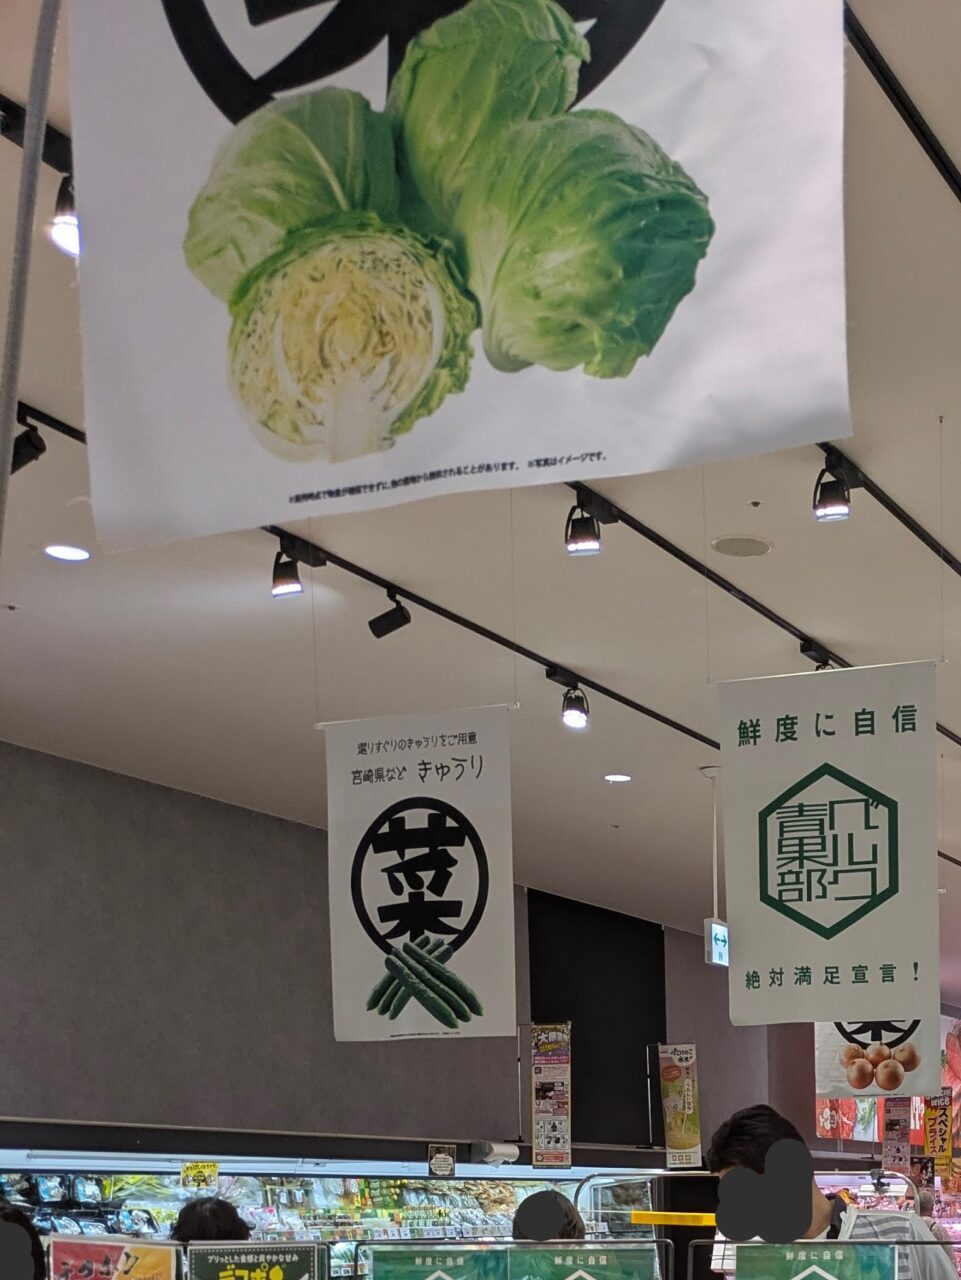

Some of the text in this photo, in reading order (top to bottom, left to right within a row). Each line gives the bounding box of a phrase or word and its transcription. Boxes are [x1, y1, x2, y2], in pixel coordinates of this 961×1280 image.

[356, 732, 479, 755] 選りすぐりのきゅうりをご用意
[737, 704, 918, 747] 鮮度に自信
[351, 755, 483, 785] 宮崎県など きゅうり
[776, 803, 828, 902] 青果部
[371, 812, 468, 942] 菜
[745, 961, 920, 990] 絶対満足宣言！
[927, 1117, 938, 1154] プライス
[937, 1107, 949, 1153] スペシャル
